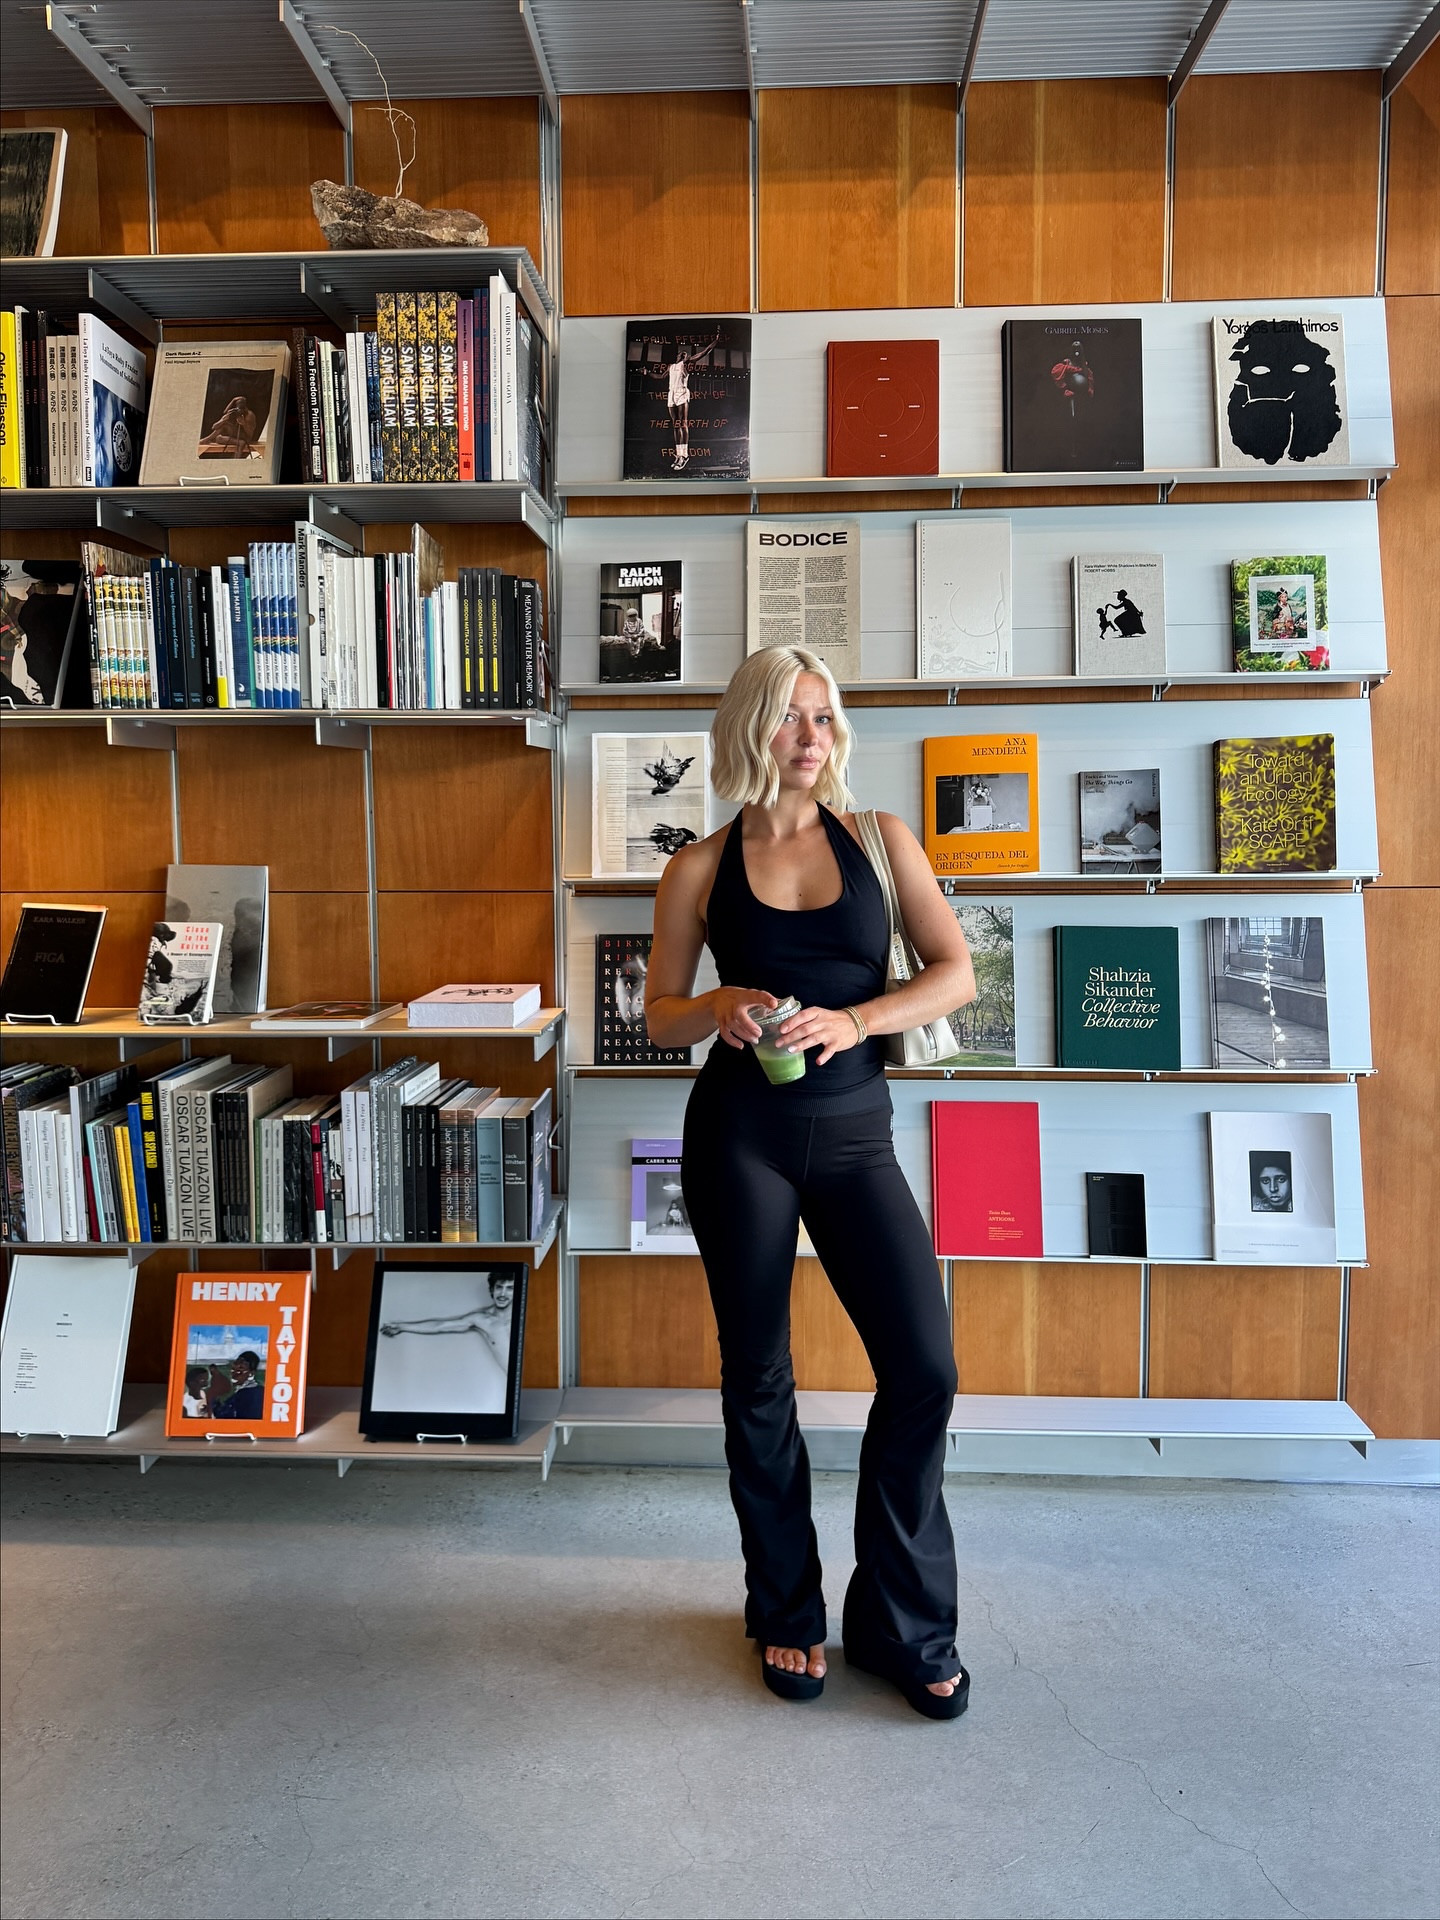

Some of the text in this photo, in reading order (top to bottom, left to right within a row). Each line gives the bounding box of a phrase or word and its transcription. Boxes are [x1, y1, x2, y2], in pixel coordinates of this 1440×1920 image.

[1045, 326, 1109, 334] GABRIEL MOSES
[1222, 317, 1339, 334] Yorgos Lanthimos
[643, 336, 671, 344] PAUL
[653, 363, 707, 372] PRLGUE
[381, 346, 396, 427] SAM GILLIAM
[402, 346, 416, 427] SAM GILLIAM
[422, 345, 435, 426] SAM GILLIAM
[442, 345, 454, 426] SAM GILLIAM
[307, 350, 320, 444] The Freedom Principle
[648, 392, 668, 400] THE
[712, 391, 726, 399] OF
[650, 419, 728, 428] THE BIRTH OF
[661, 448, 711, 457] FRDOM
[759, 532, 848, 546] BODICE
[620, 567, 661, 578] RALPH
[618, 576, 663, 587] LEMON
[524, 594, 532, 630] MEANING
[525, 660, 533, 693] MEMORY
[1005, 738, 1027, 746] ANA
[972, 746, 1027, 756] MENDIETA
[1247, 752, 1305, 768] Toward
[1240, 769, 1313, 785] an Urban
[1246, 786, 1309, 804] Ecology
[1241, 816, 1314, 832] Kate Orff
[1249, 833, 1306, 849] SCAPE
[935, 850, 1029, 861] EN BÚSQUEDA DEL
[935, 861, 973, 870] ORIGEN
[34, 952, 65, 963] FIGA
[1089, 966, 1151, 982] Shahzia
[1084, 981, 1156, 997] Sikander
[1081, 997, 1161, 1014] Collective
[1083, 1011, 1158, 1029] Behavior
[604, 1053, 685, 1061] REACTION
[142, 1105, 154, 1120] WARD
[144, 1131, 156, 1142] SUN
[162, 1113, 171, 1146] Thiebaud
[144, 1143, 157, 1168] SPLASHED
[165, 1148, 173, 1176] Summer
[445, 1146, 453, 1174] Whitten
[464, 1146, 472, 1174] Whitten
[177, 1095, 194, 1238] OSCAR TUAZON LIVE
[194, 1095, 212, 1238] OSCAR TUAZON LIVE
[191, 1281, 282, 1301] HENRY
[271, 1306, 298, 1423] TAYLOR
